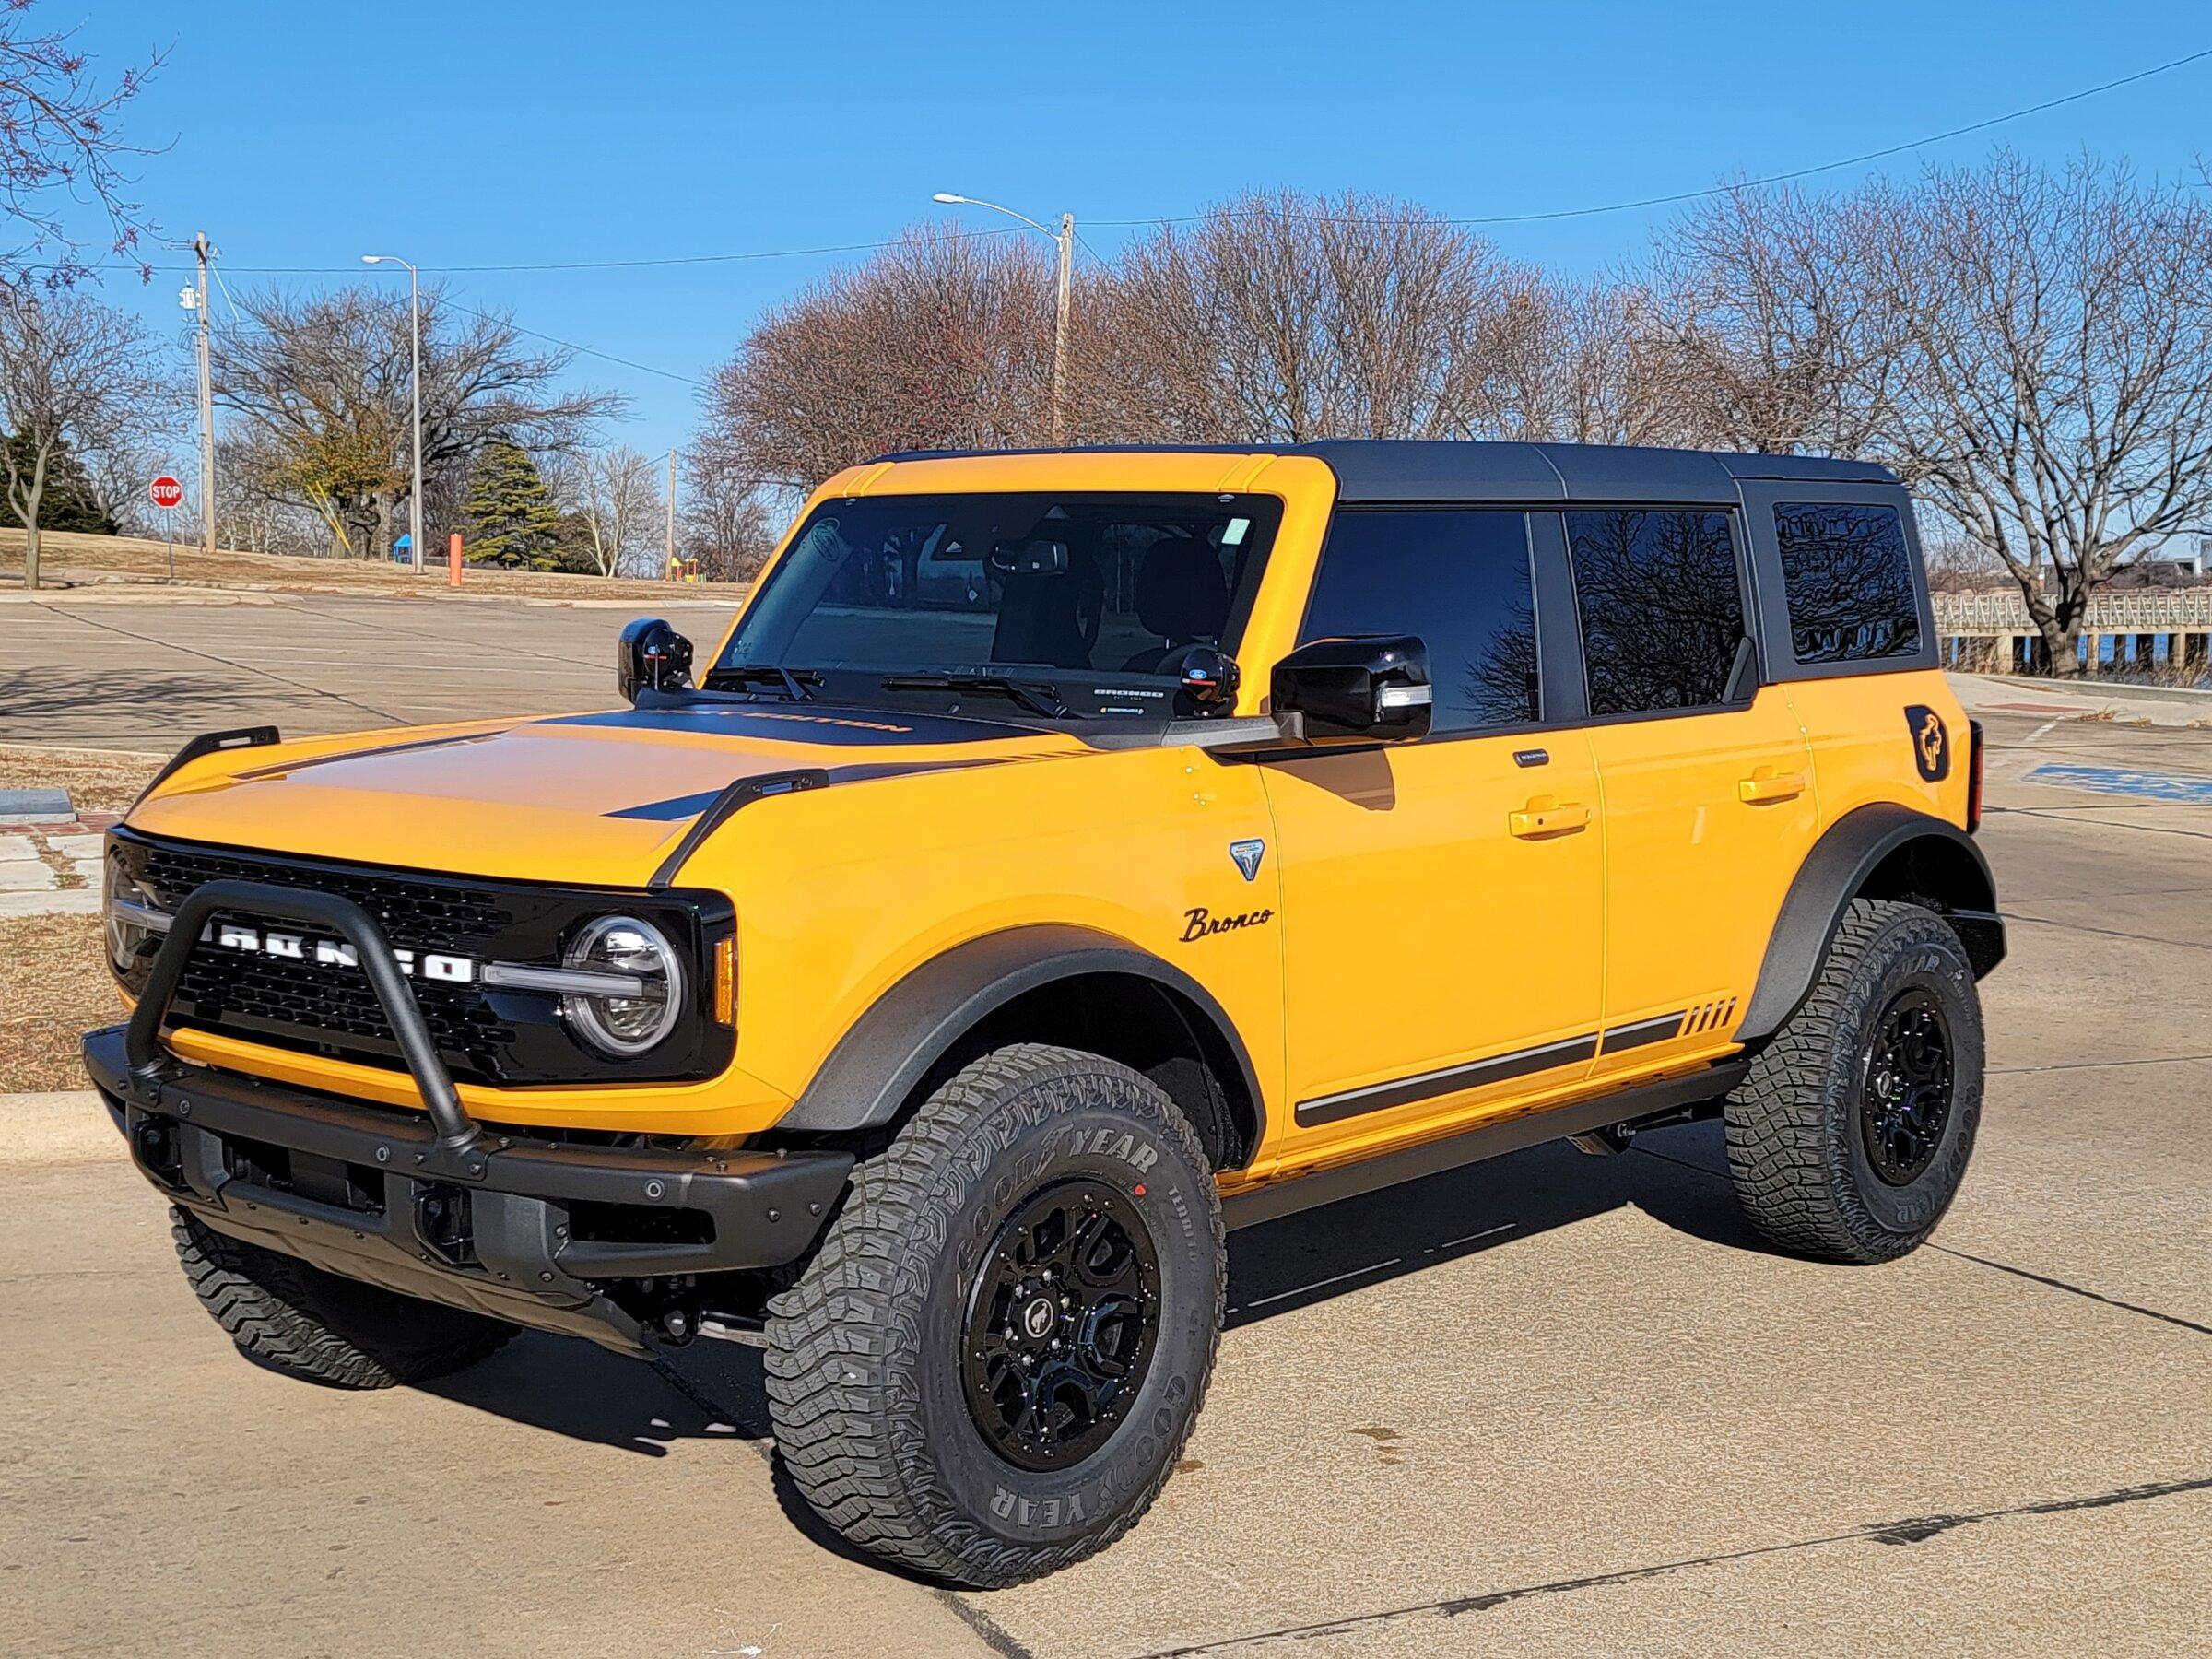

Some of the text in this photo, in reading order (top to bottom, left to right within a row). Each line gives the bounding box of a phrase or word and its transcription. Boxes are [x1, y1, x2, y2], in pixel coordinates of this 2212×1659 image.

[152, 485, 181, 499] STOP
[1179, 907, 1275, 943] Bronco
[199, 922, 473, 983] RONO
